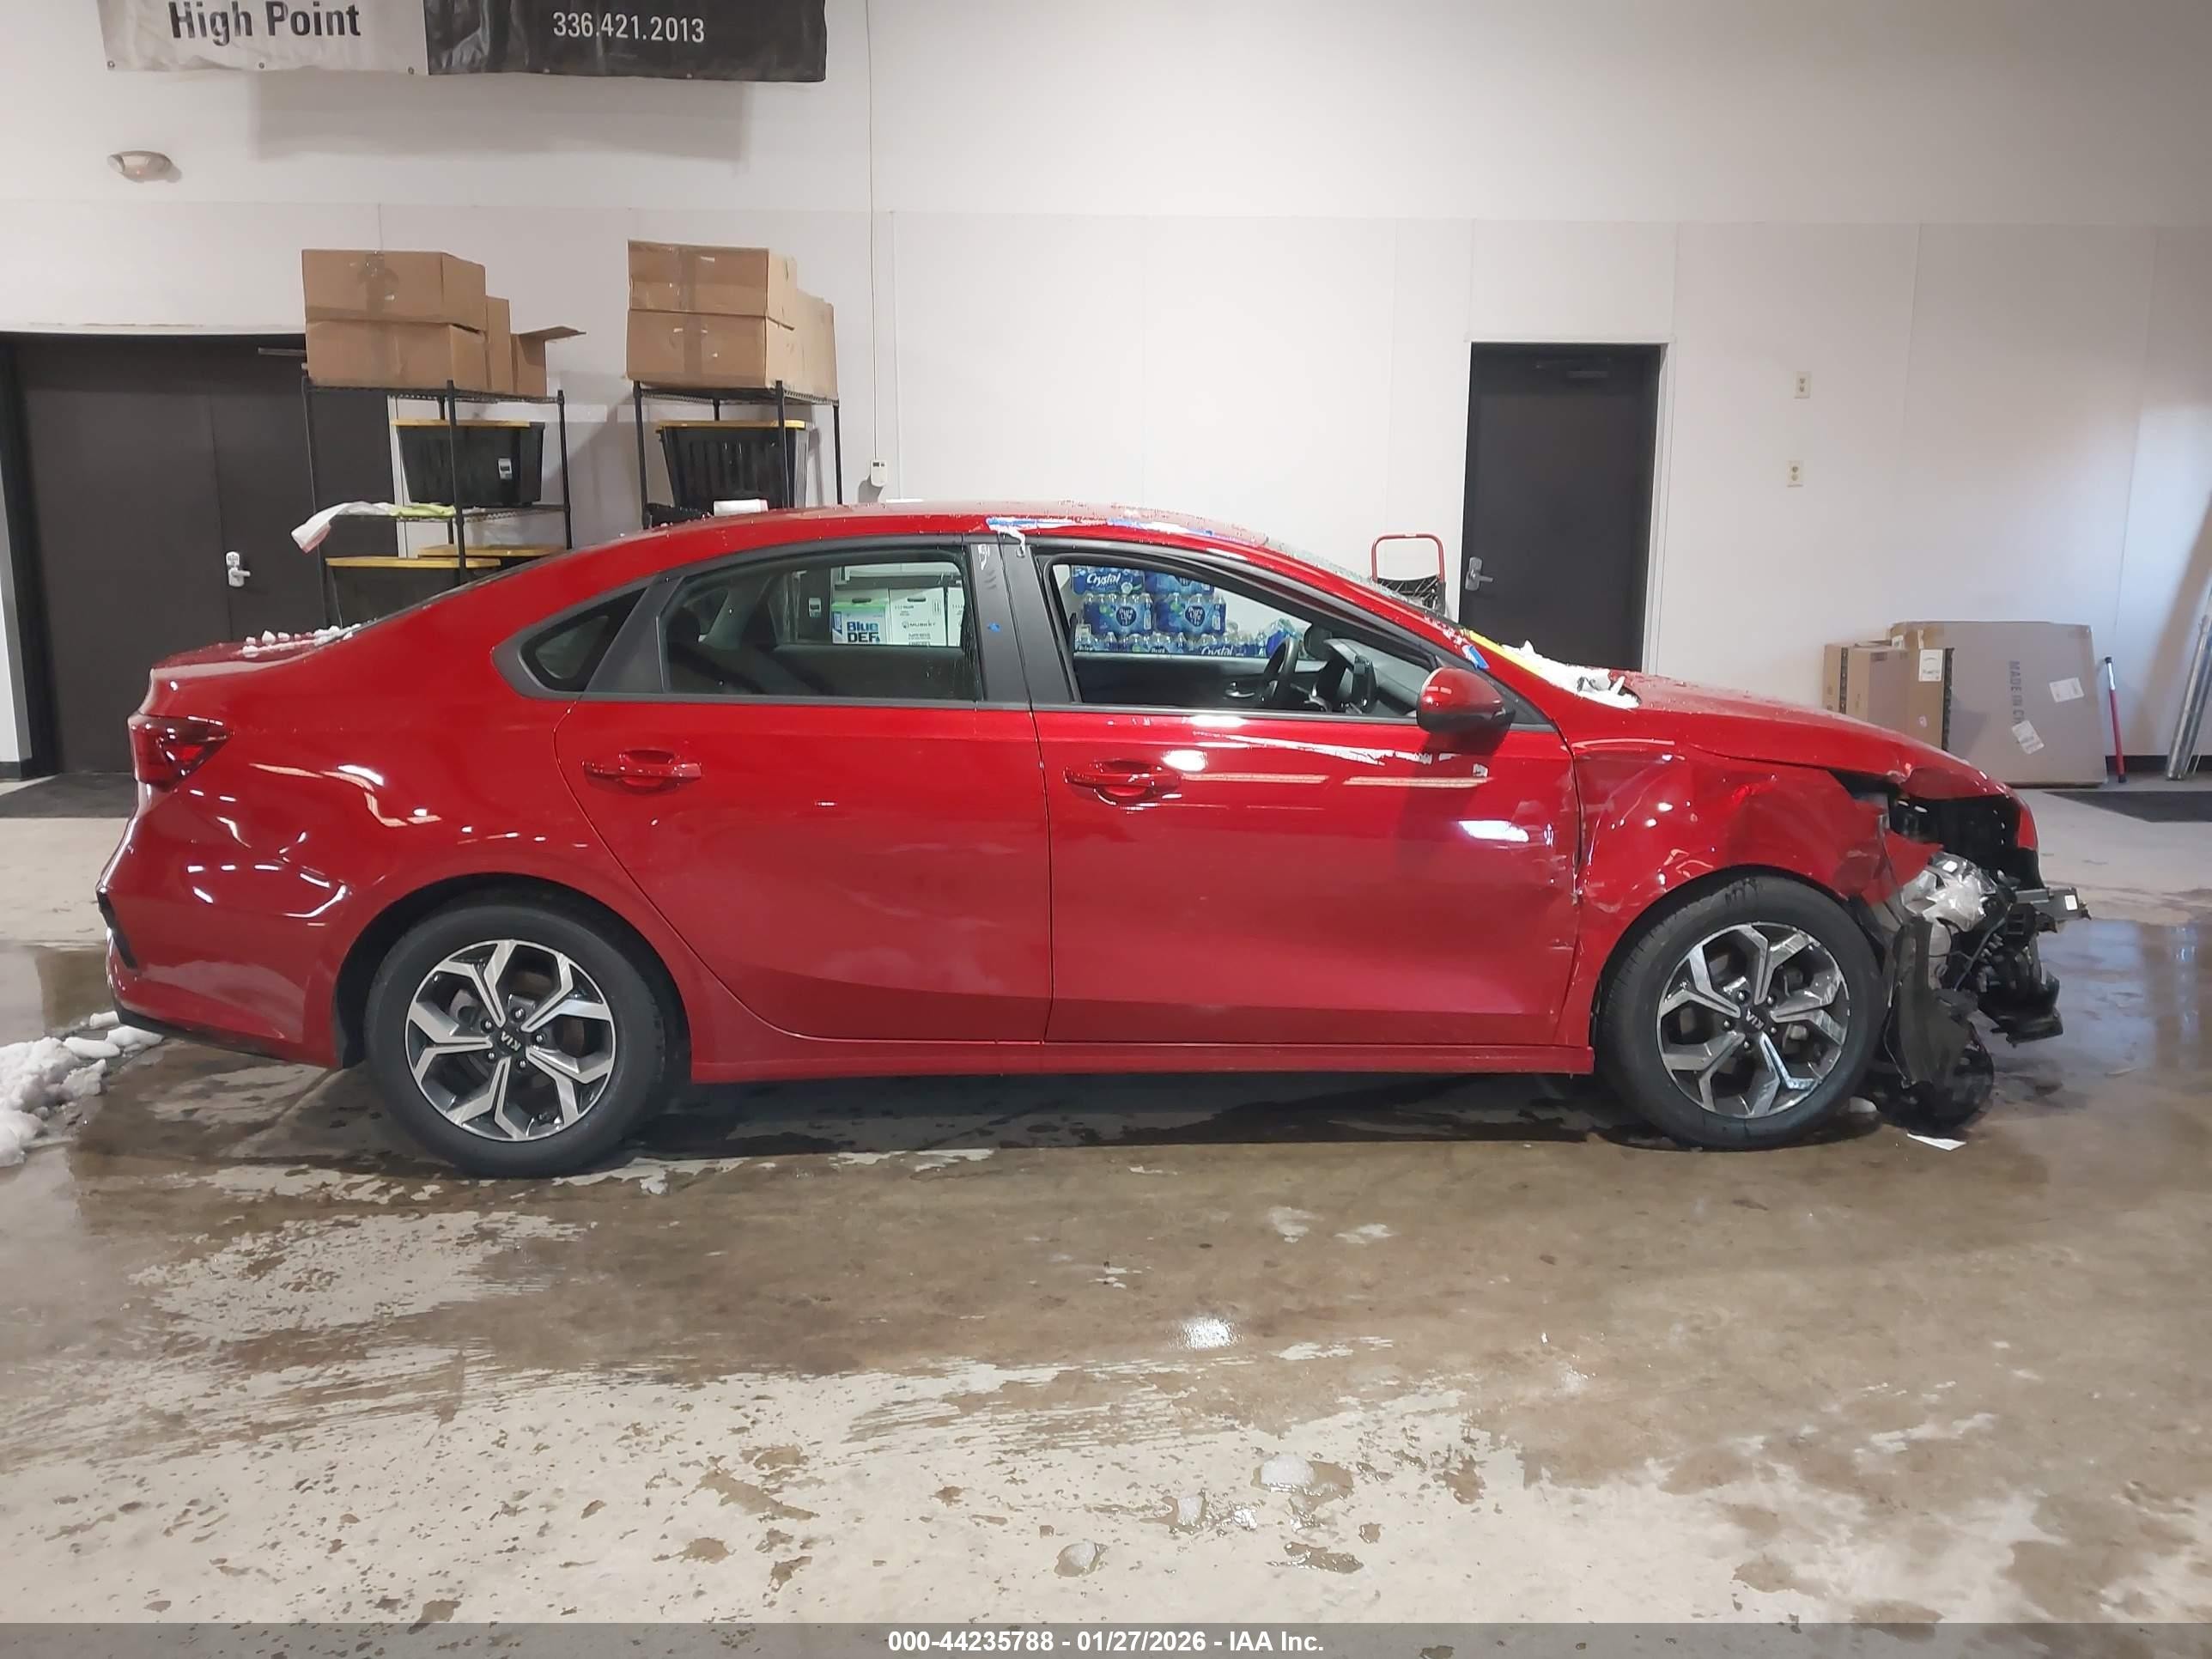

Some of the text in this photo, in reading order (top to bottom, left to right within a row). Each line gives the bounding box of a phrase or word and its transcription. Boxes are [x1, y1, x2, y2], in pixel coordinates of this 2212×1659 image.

[167, 1, 362, 46] High Point
[552, 12, 705, 43] 336.421.2013
[1086, 573, 1121, 586] Crystal
[847, 621, 879, 632] Blue
[848, 632, 879, 643] DEF
[2008, 659, 2022, 691] MADE
[2011, 695, 2023, 707] IN
